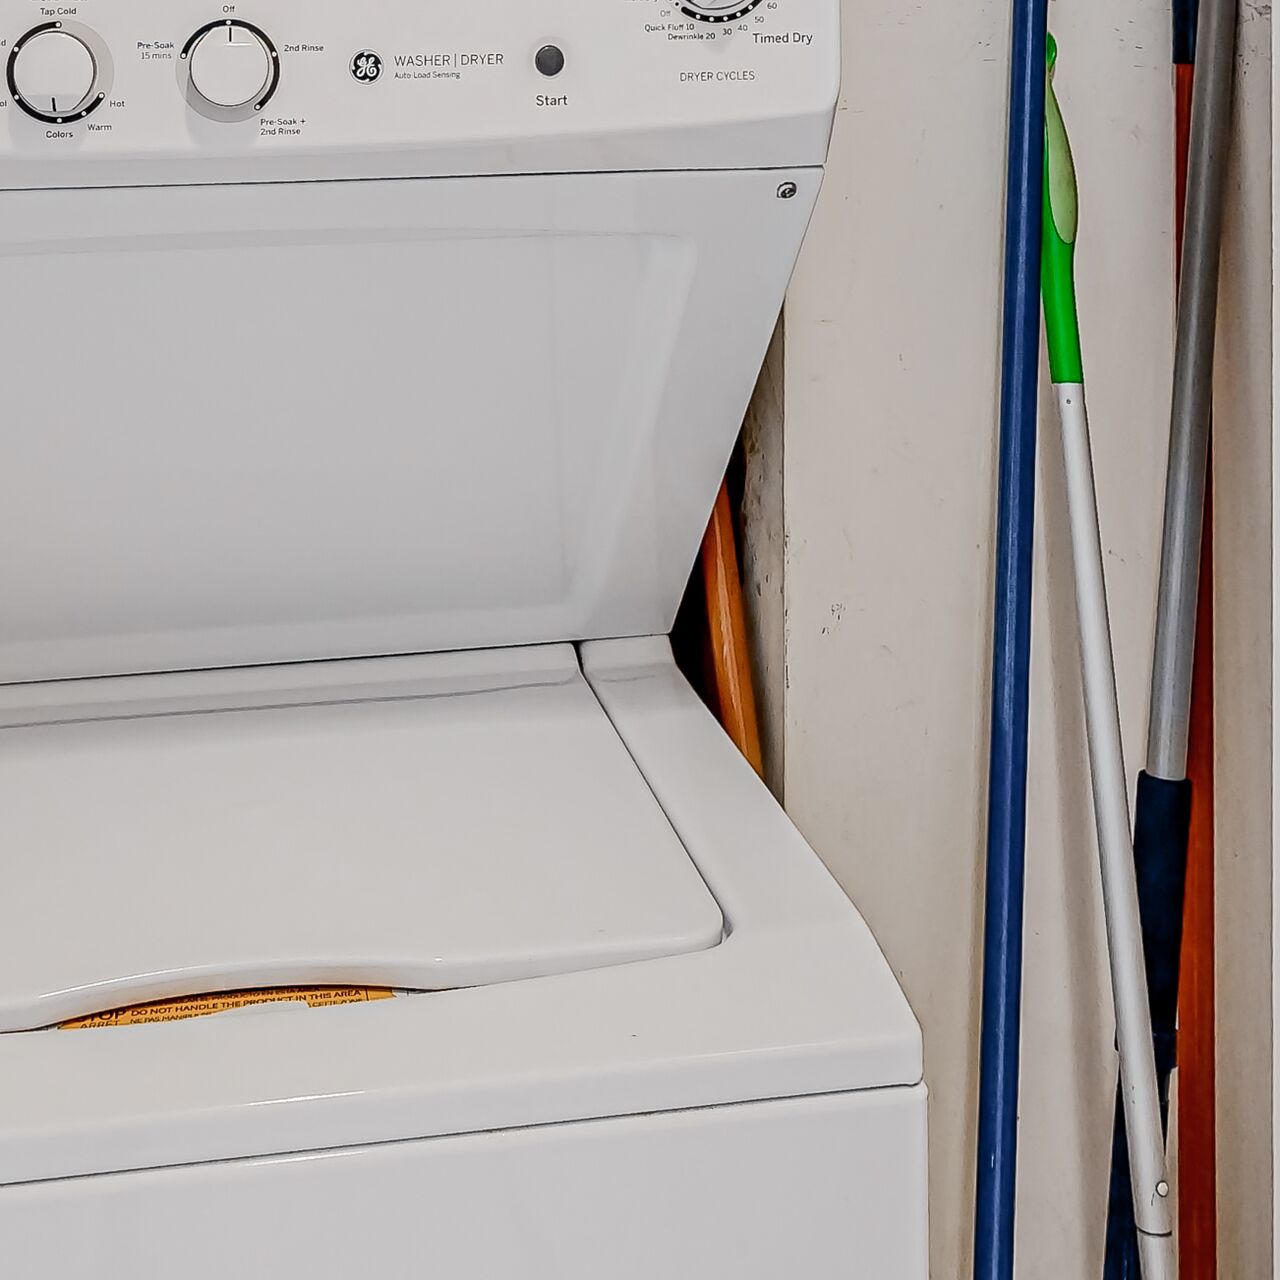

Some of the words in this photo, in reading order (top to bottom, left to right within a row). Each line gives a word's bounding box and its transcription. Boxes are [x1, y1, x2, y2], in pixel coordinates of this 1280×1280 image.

[40, 7, 55, 17] Tap
[57, 7, 77, 15] Cold
[222, 5, 235, 13] Off
[644, 24, 666, 32] Quick
[753, 33, 789, 44] Timed
[793, 32, 813, 45] Dry
[137, 41, 175, 50] Pre-Soak
[284, 44, 299, 52] 2nd
[301, 44, 324, 52] Rinse
[141, 52, 150, 60] 15
[394, 55, 450, 66] WASHER
[461, 54, 504, 65] DRYER
[414, 71, 431, 79] Load
[433, 71, 460, 80] Sensing
[680, 72, 713, 82] DRYER
[716, 71, 755, 81] CYCLES
[109, 100, 125, 108] Hot
[536, 95, 568, 106] Start
[260, 118, 298, 126] Pre-Soak
[87, 123, 112, 131] Warm
[46, 130, 73, 139] Colors
[260, 128, 275, 136] 2nd
[278, 128, 301, 136] Rinse
[150, 1007, 173, 1015] NOT
[176, 1003, 218, 1012] HANDLE
[309, 992, 332, 1000] THIS
[333, 990, 361, 998] AREA
